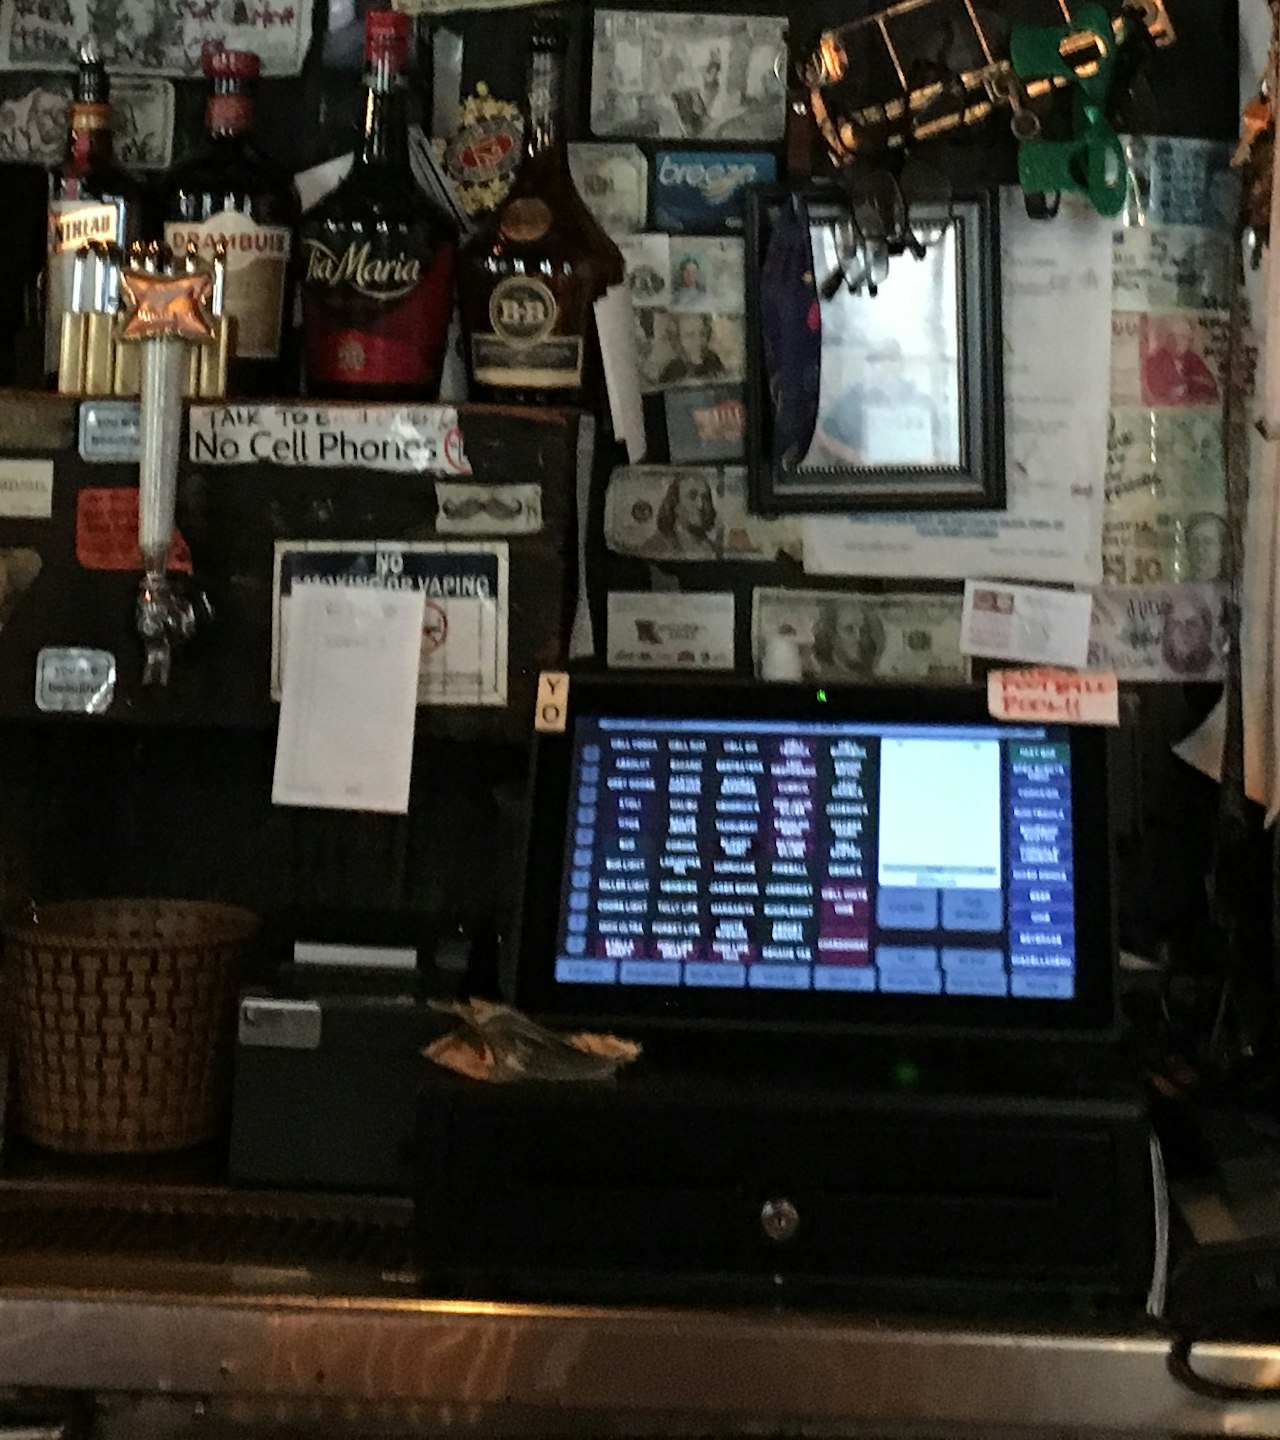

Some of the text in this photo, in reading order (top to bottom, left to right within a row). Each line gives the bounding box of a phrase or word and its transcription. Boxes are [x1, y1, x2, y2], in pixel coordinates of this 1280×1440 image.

[332, 239, 421, 285] Maria
[194, 427, 438, 462] No Cell Phones
[374, 551, 404, 575] NO
[419, 575, 491, 598] VAPING
